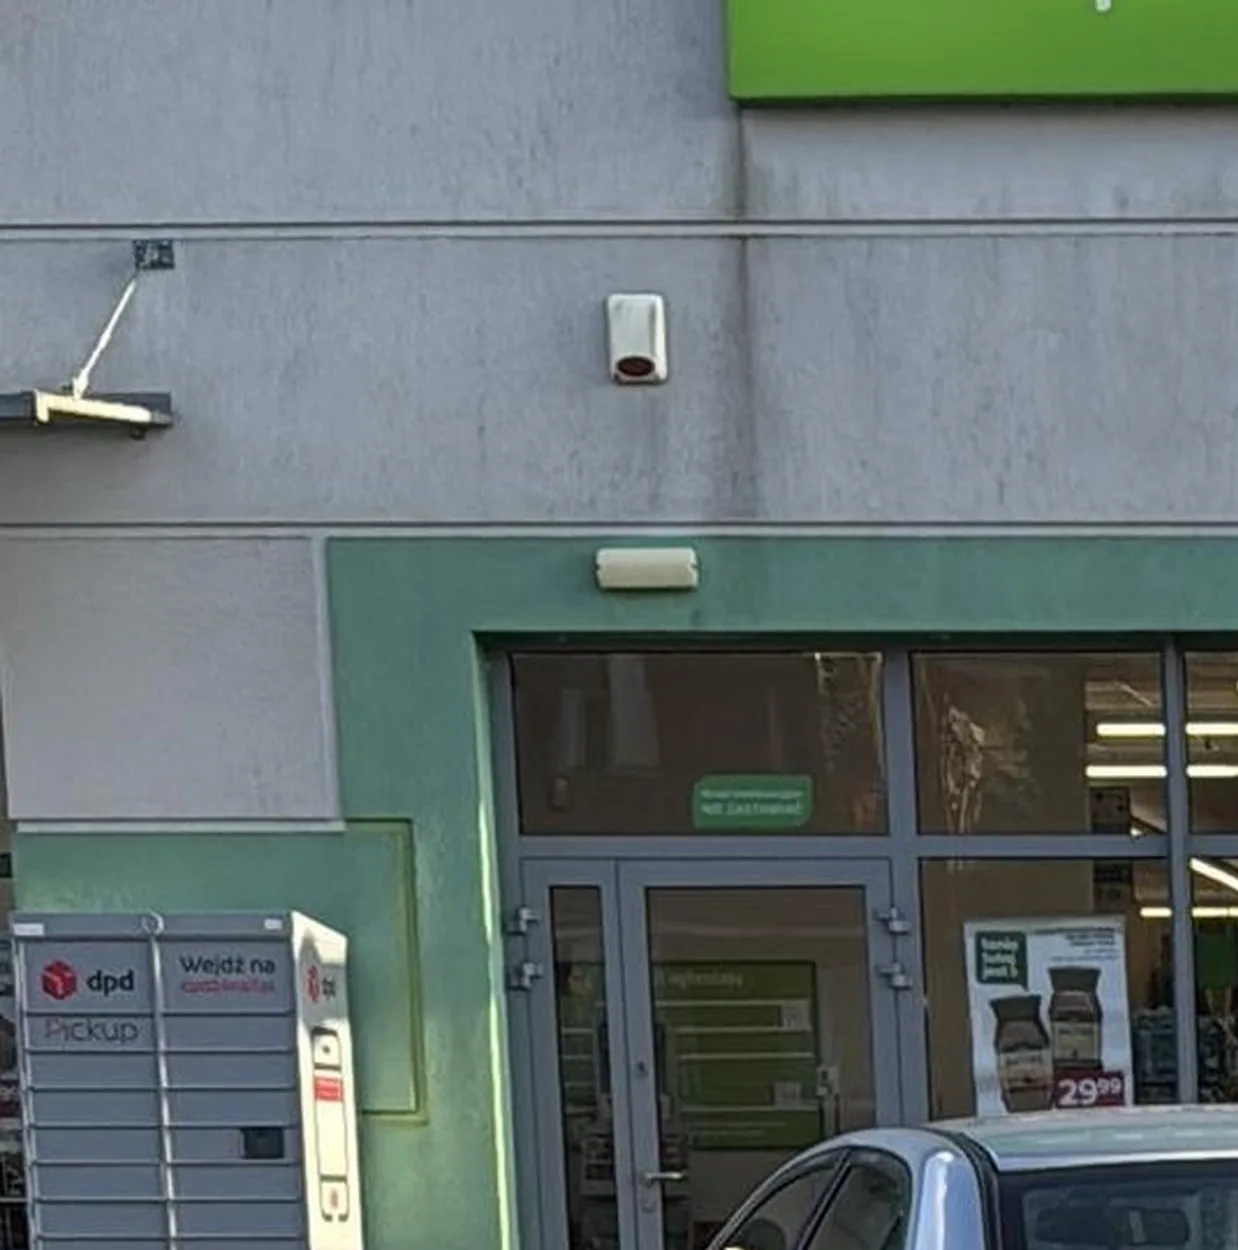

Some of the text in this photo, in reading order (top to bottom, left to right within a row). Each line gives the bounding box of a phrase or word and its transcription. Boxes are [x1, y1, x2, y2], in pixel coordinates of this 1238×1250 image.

[250, 958, 276, 975] na
[87, 969, 135, 997] dpd
[44, 1018, 139, 1044] Pickup
